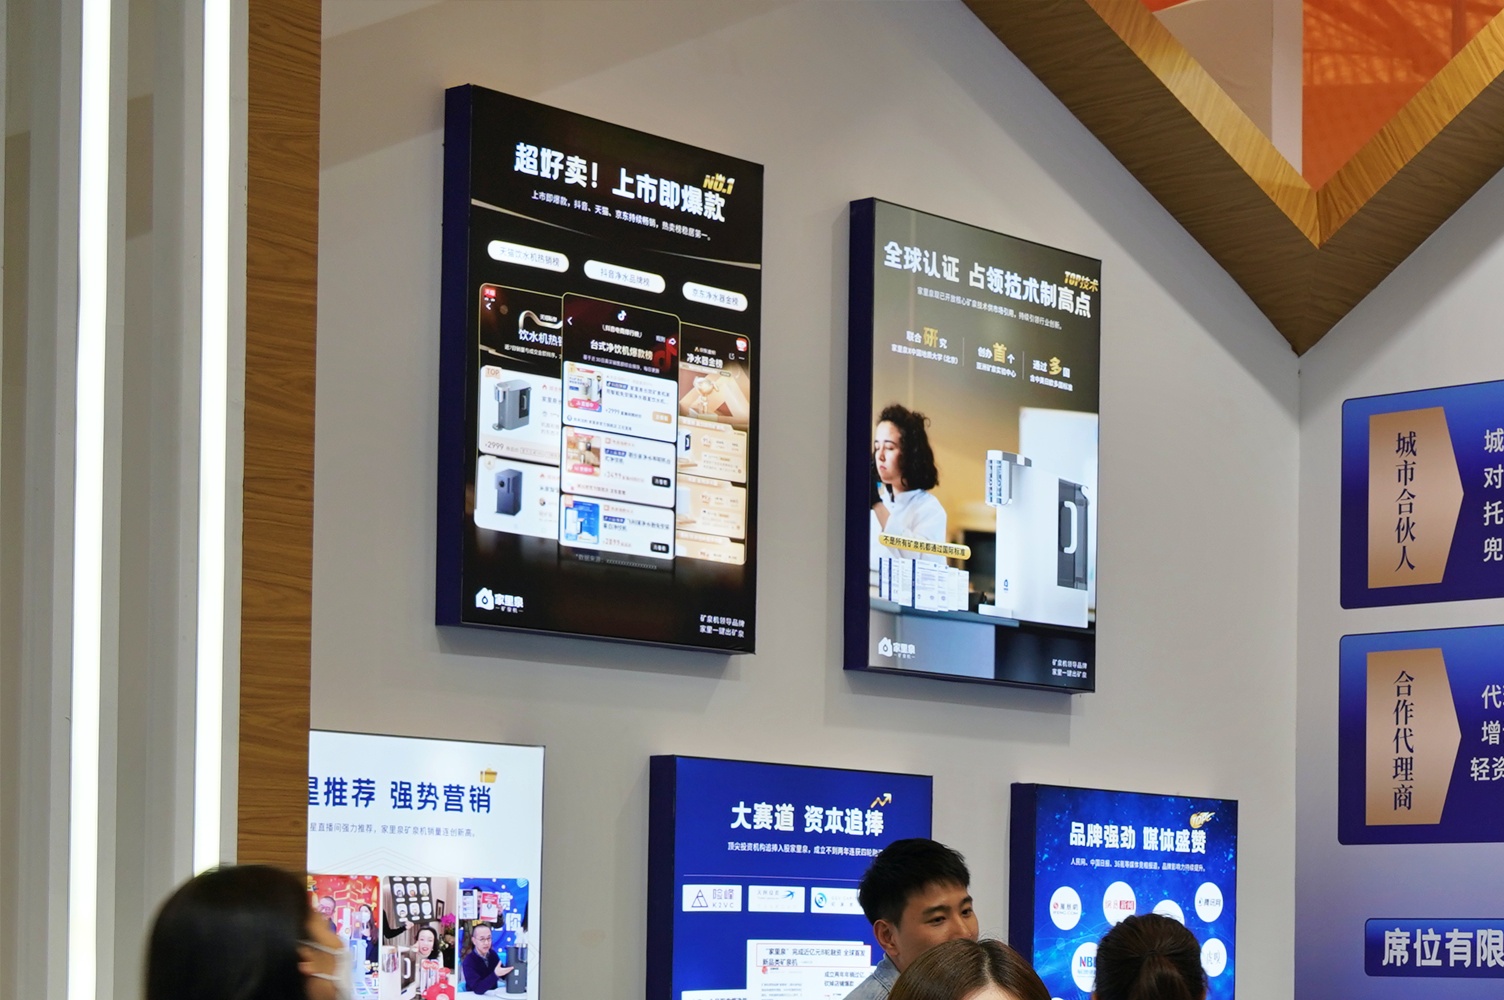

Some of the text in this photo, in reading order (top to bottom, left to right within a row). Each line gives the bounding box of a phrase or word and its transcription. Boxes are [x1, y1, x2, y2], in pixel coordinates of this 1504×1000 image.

[884, 241, 1091, 318] 全球认证 占领技术制高点
[1395, 431, 1417, 573] 城市合伙人
[883, 535, 966, 557] 不是所有矿泉机都通过国际标准
[1392, 670, 1415, 811] 合作代理商
[390, 780, 491, 814] 强势营销
[731, 801, 884, 837] 大赛道 资本追捧
[1070, 821, 1206, 854] 品牌强劲 媒体盛赞
